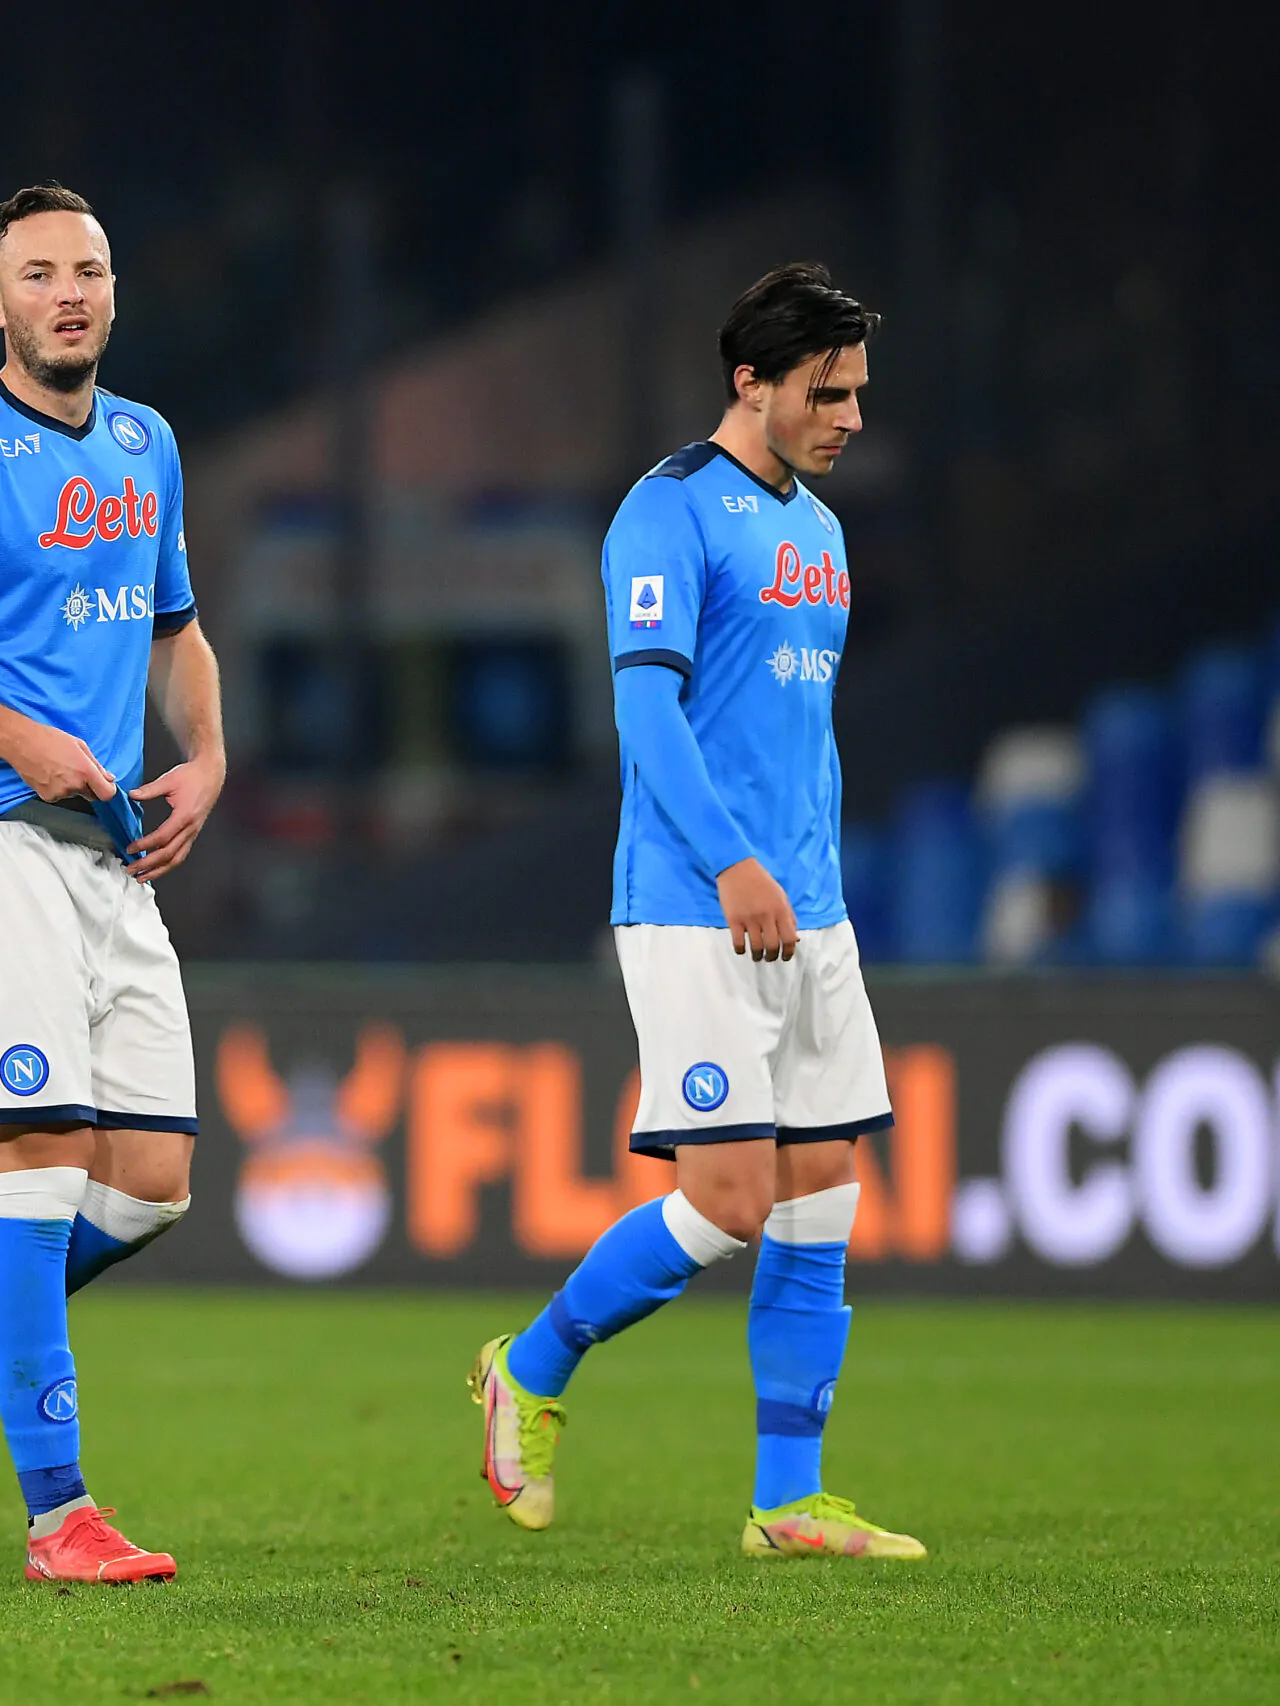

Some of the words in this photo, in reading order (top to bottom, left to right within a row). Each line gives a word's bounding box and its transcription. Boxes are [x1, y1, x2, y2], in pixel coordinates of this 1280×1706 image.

[0, 432, 41, 458] EA7
[116, 421, 140, 444] N
[37, 475, 159, 550] Lete
[721, 495, 760, 514] EA7
[759, 540, 851, 609] Lete
[11, 1057, 35, 1083] N
[693, 1073, 715, 1100] N
[55, 1387, 75, 1413] N
